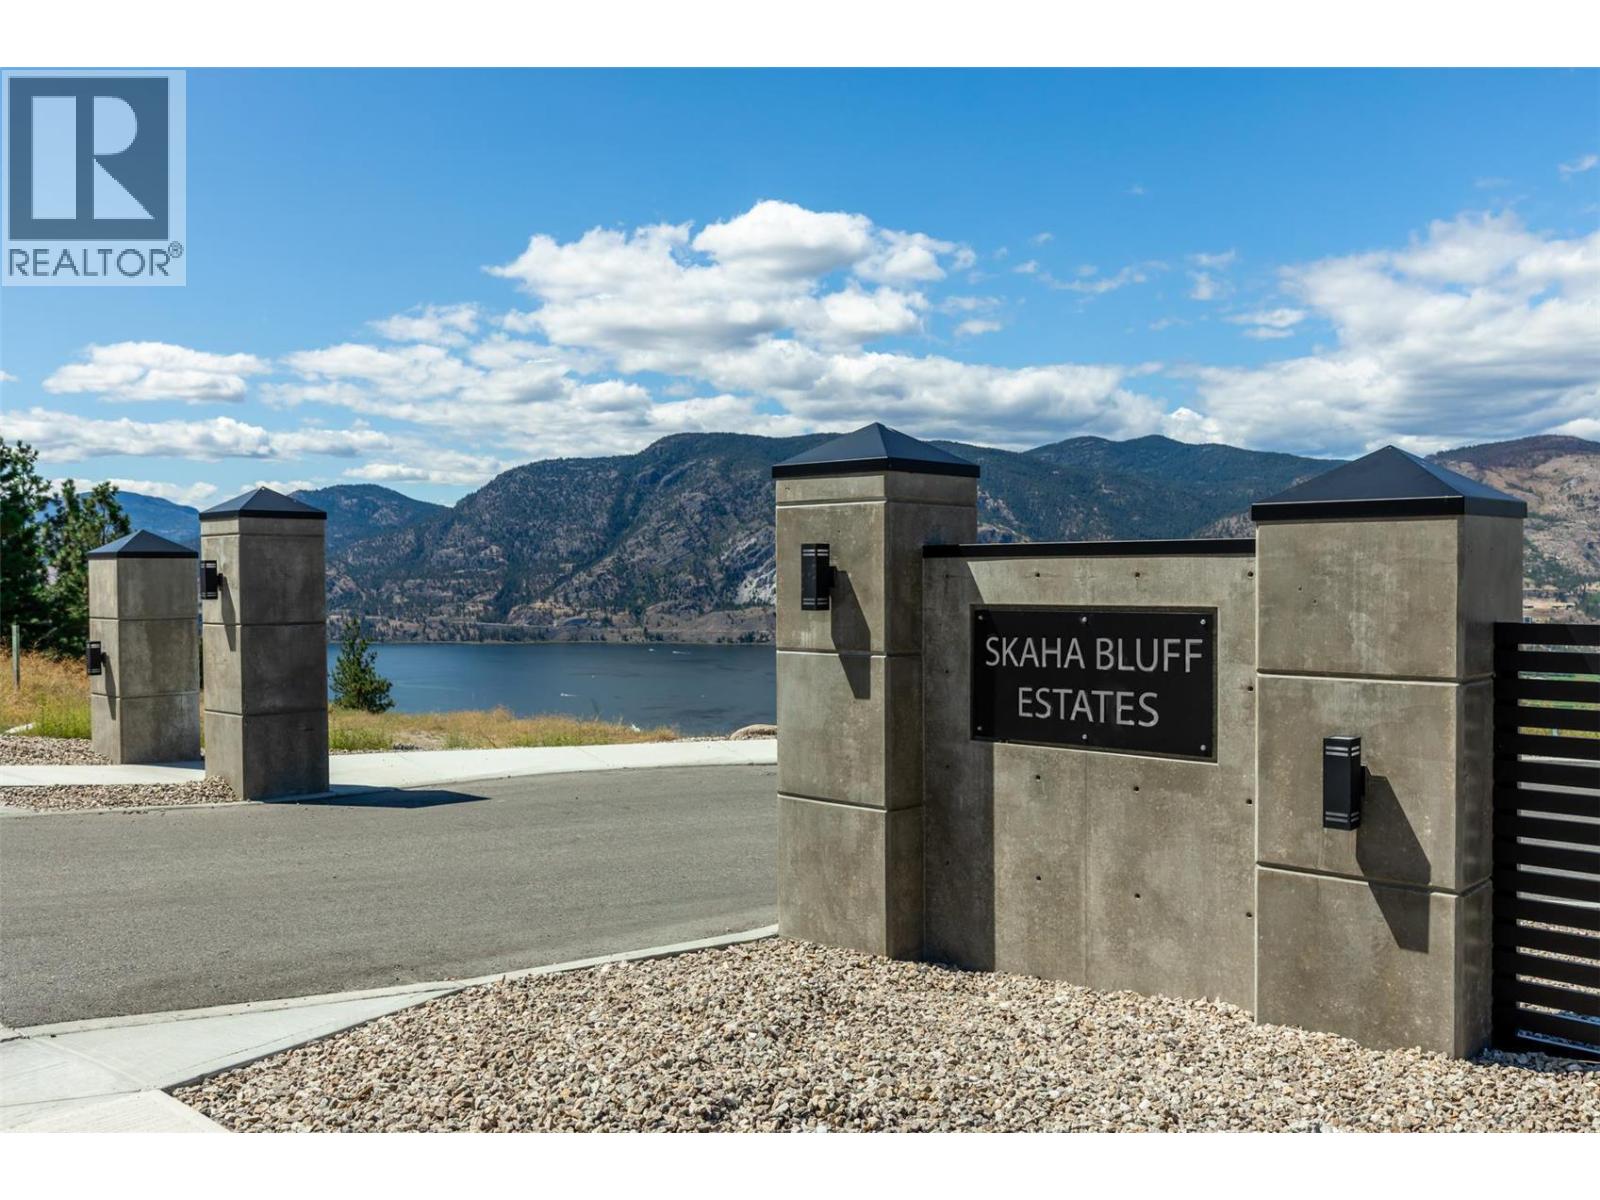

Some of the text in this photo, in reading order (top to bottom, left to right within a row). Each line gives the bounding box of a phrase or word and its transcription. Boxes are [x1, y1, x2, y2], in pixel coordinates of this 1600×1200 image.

[985, 636, 1203, 673] SKAHA BLUFF
[1018, 687, 1160, 727] ESTATES
